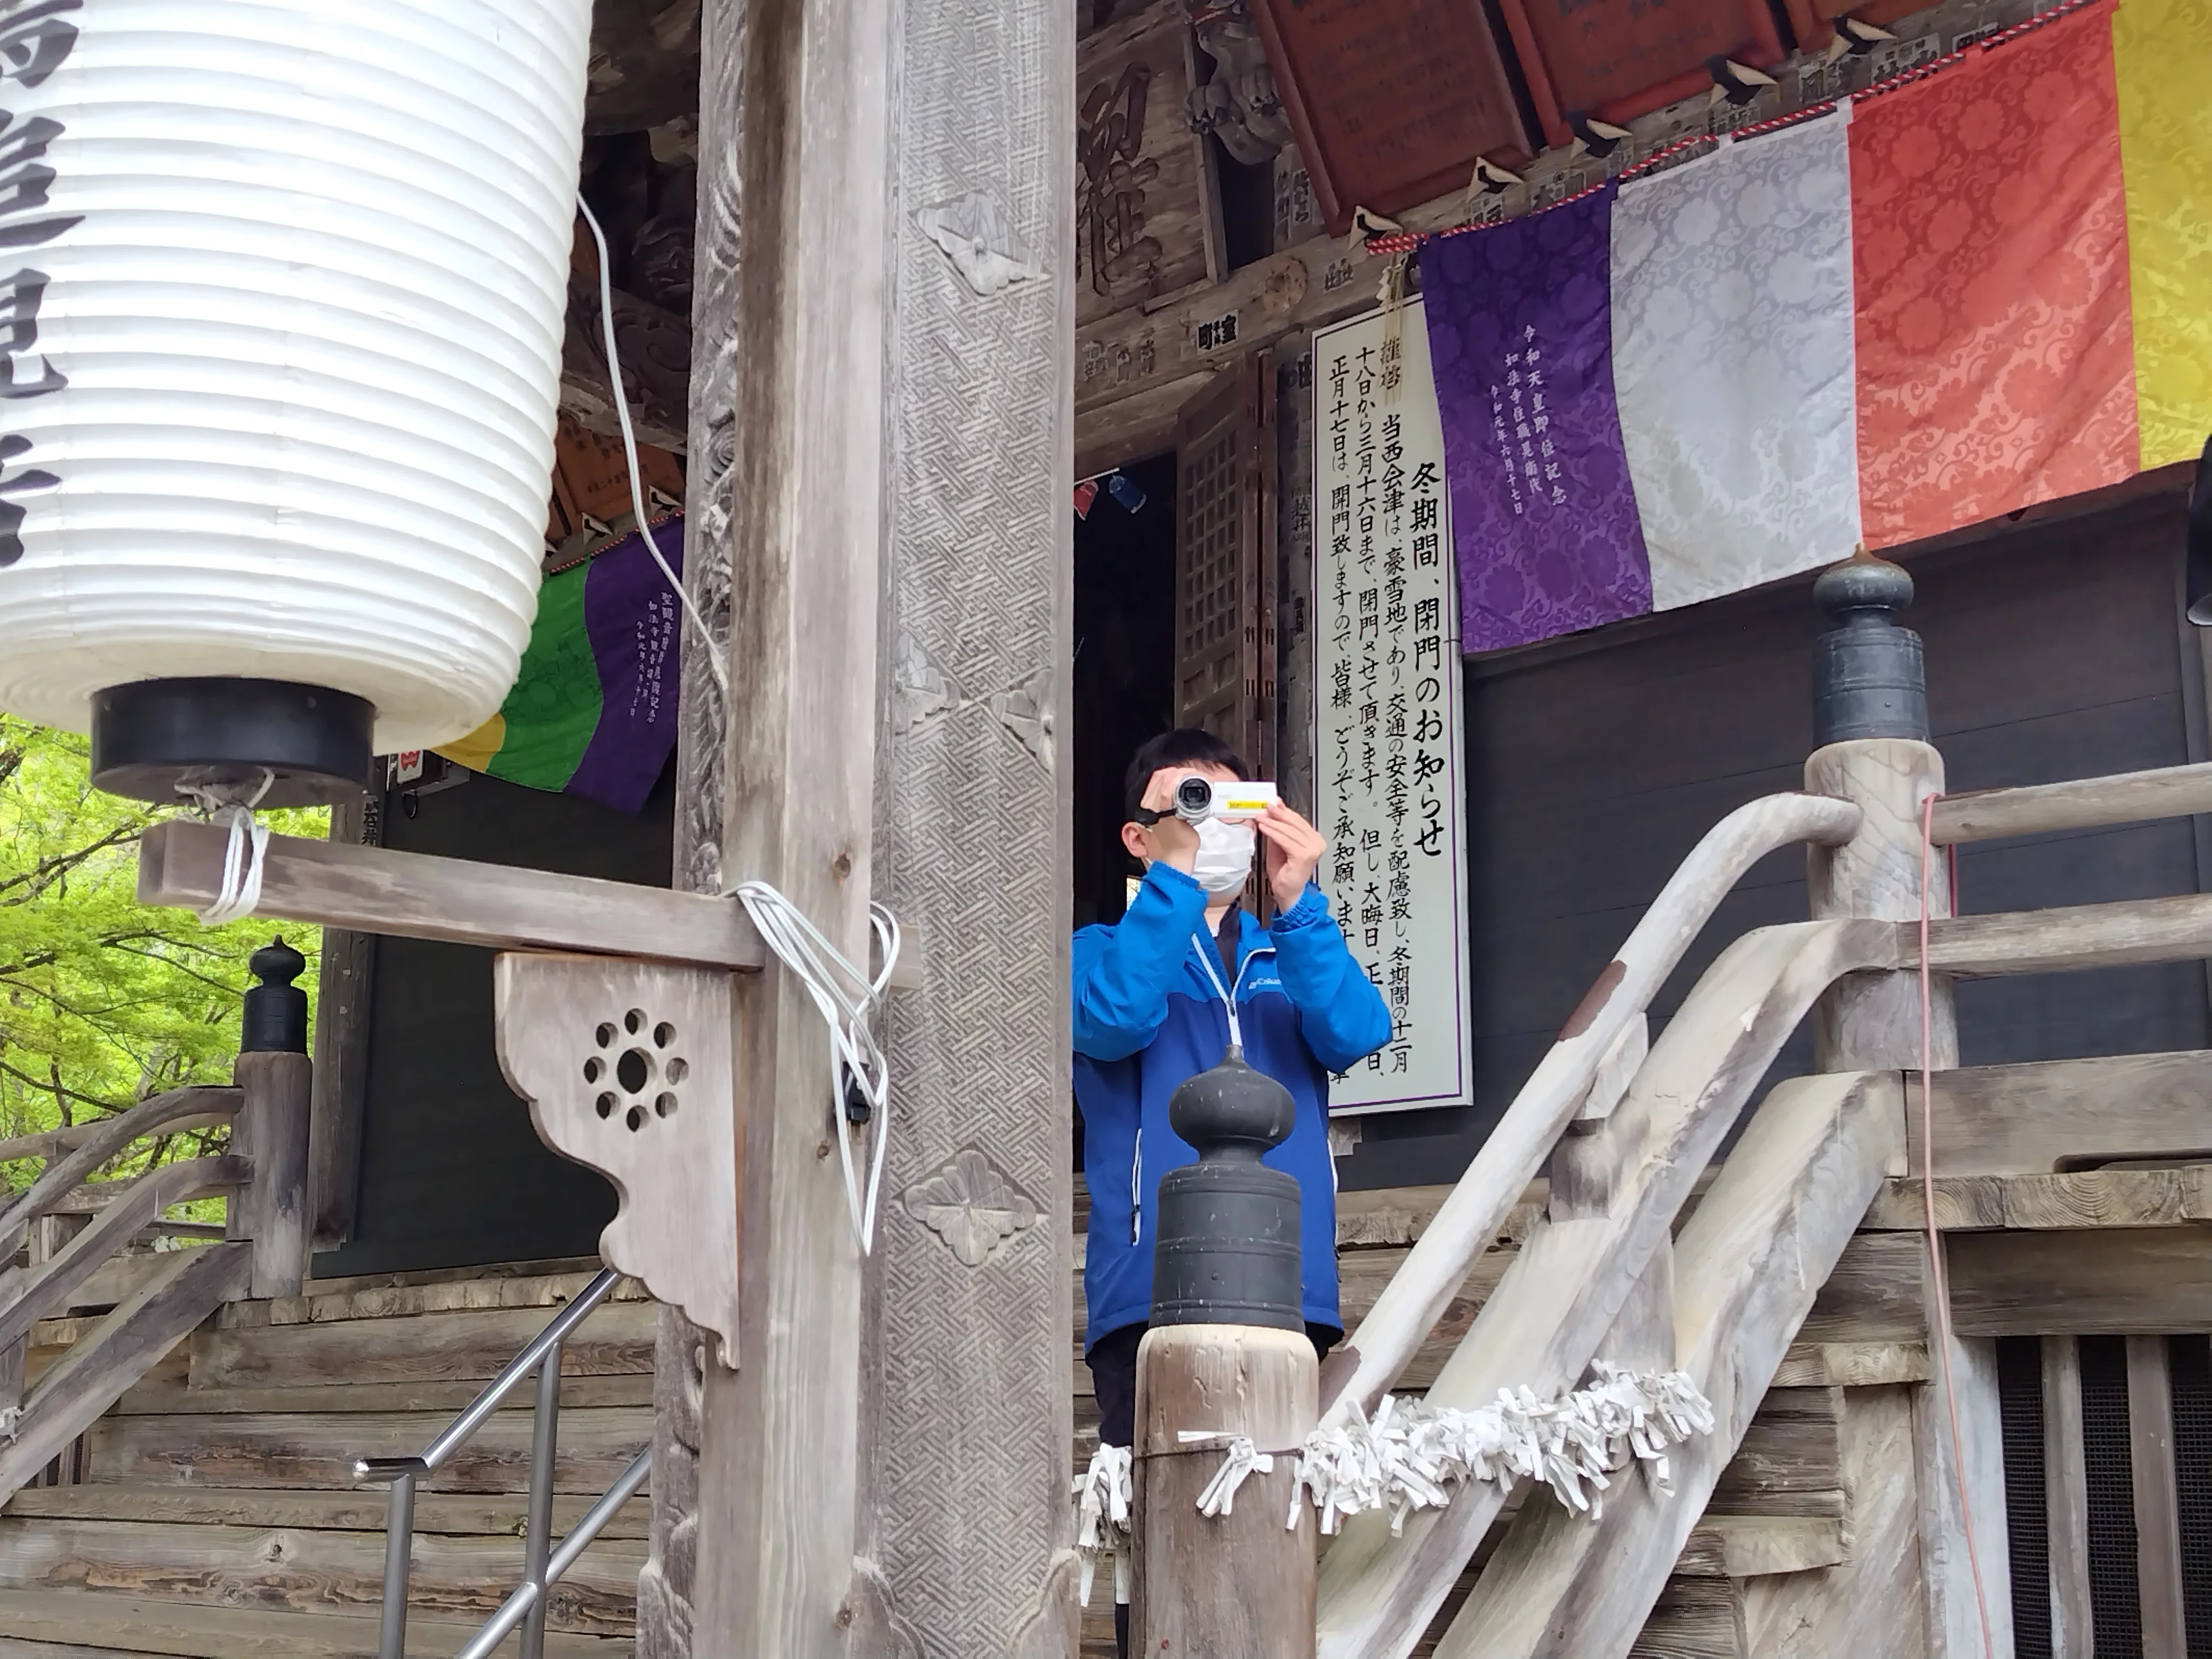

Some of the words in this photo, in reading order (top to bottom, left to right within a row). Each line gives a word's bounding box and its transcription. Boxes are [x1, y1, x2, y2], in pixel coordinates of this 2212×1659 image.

[1410, 462, 1445, 857] 冬期間、閉門のお知らせ
